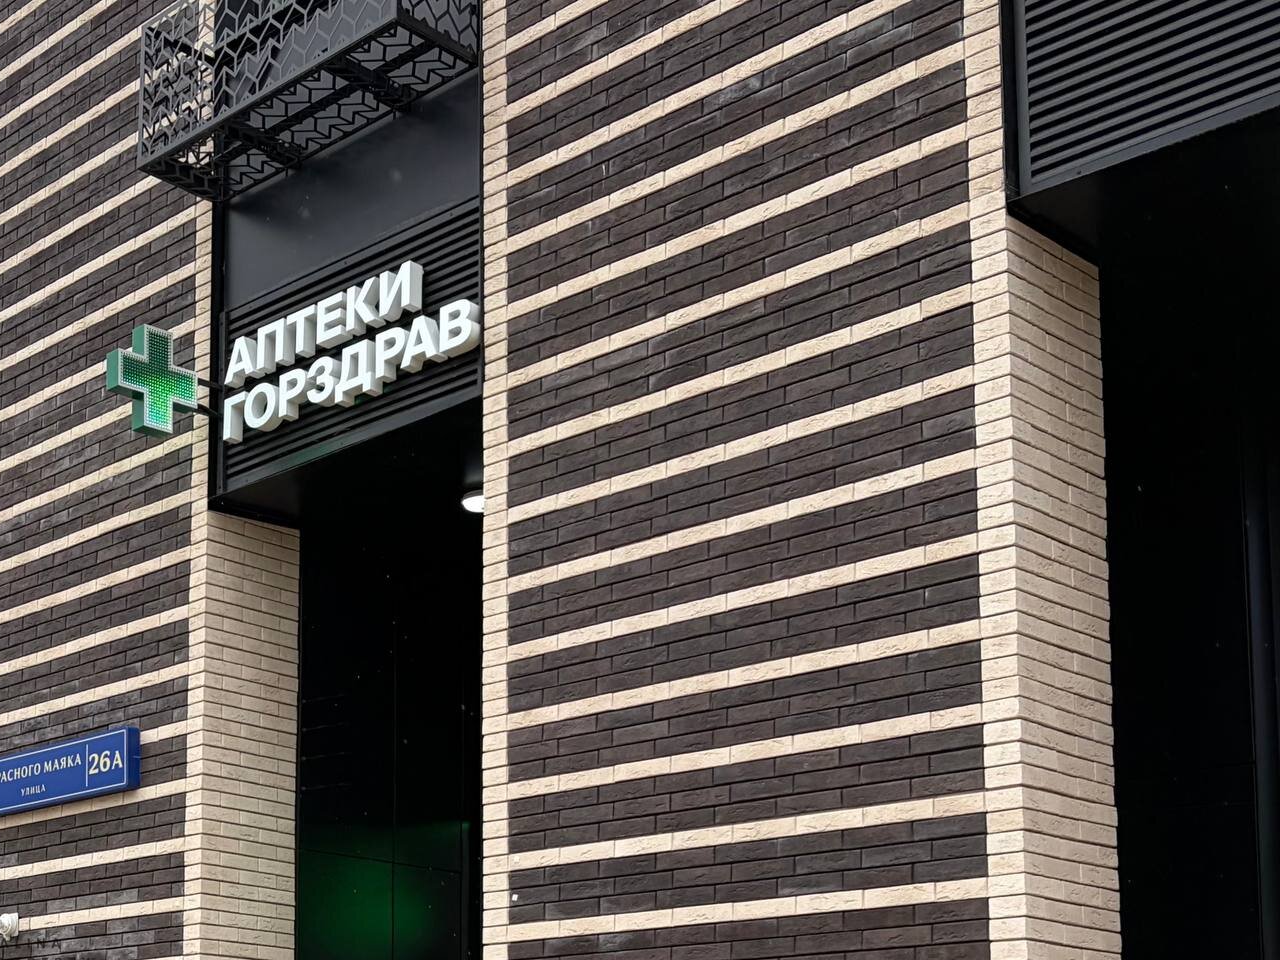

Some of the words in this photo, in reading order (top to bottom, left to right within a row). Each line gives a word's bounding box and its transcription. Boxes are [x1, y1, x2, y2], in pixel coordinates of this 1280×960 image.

[224, 260, 424, 388] АПТЕКИ
[223, 299, 480, 444] ГОРЗДРАВ
[21, 784, 47, 797] УЛИЦА
[44, 753, 82, 774] МАЯКА
[88, 750, 124, 776] 26А
